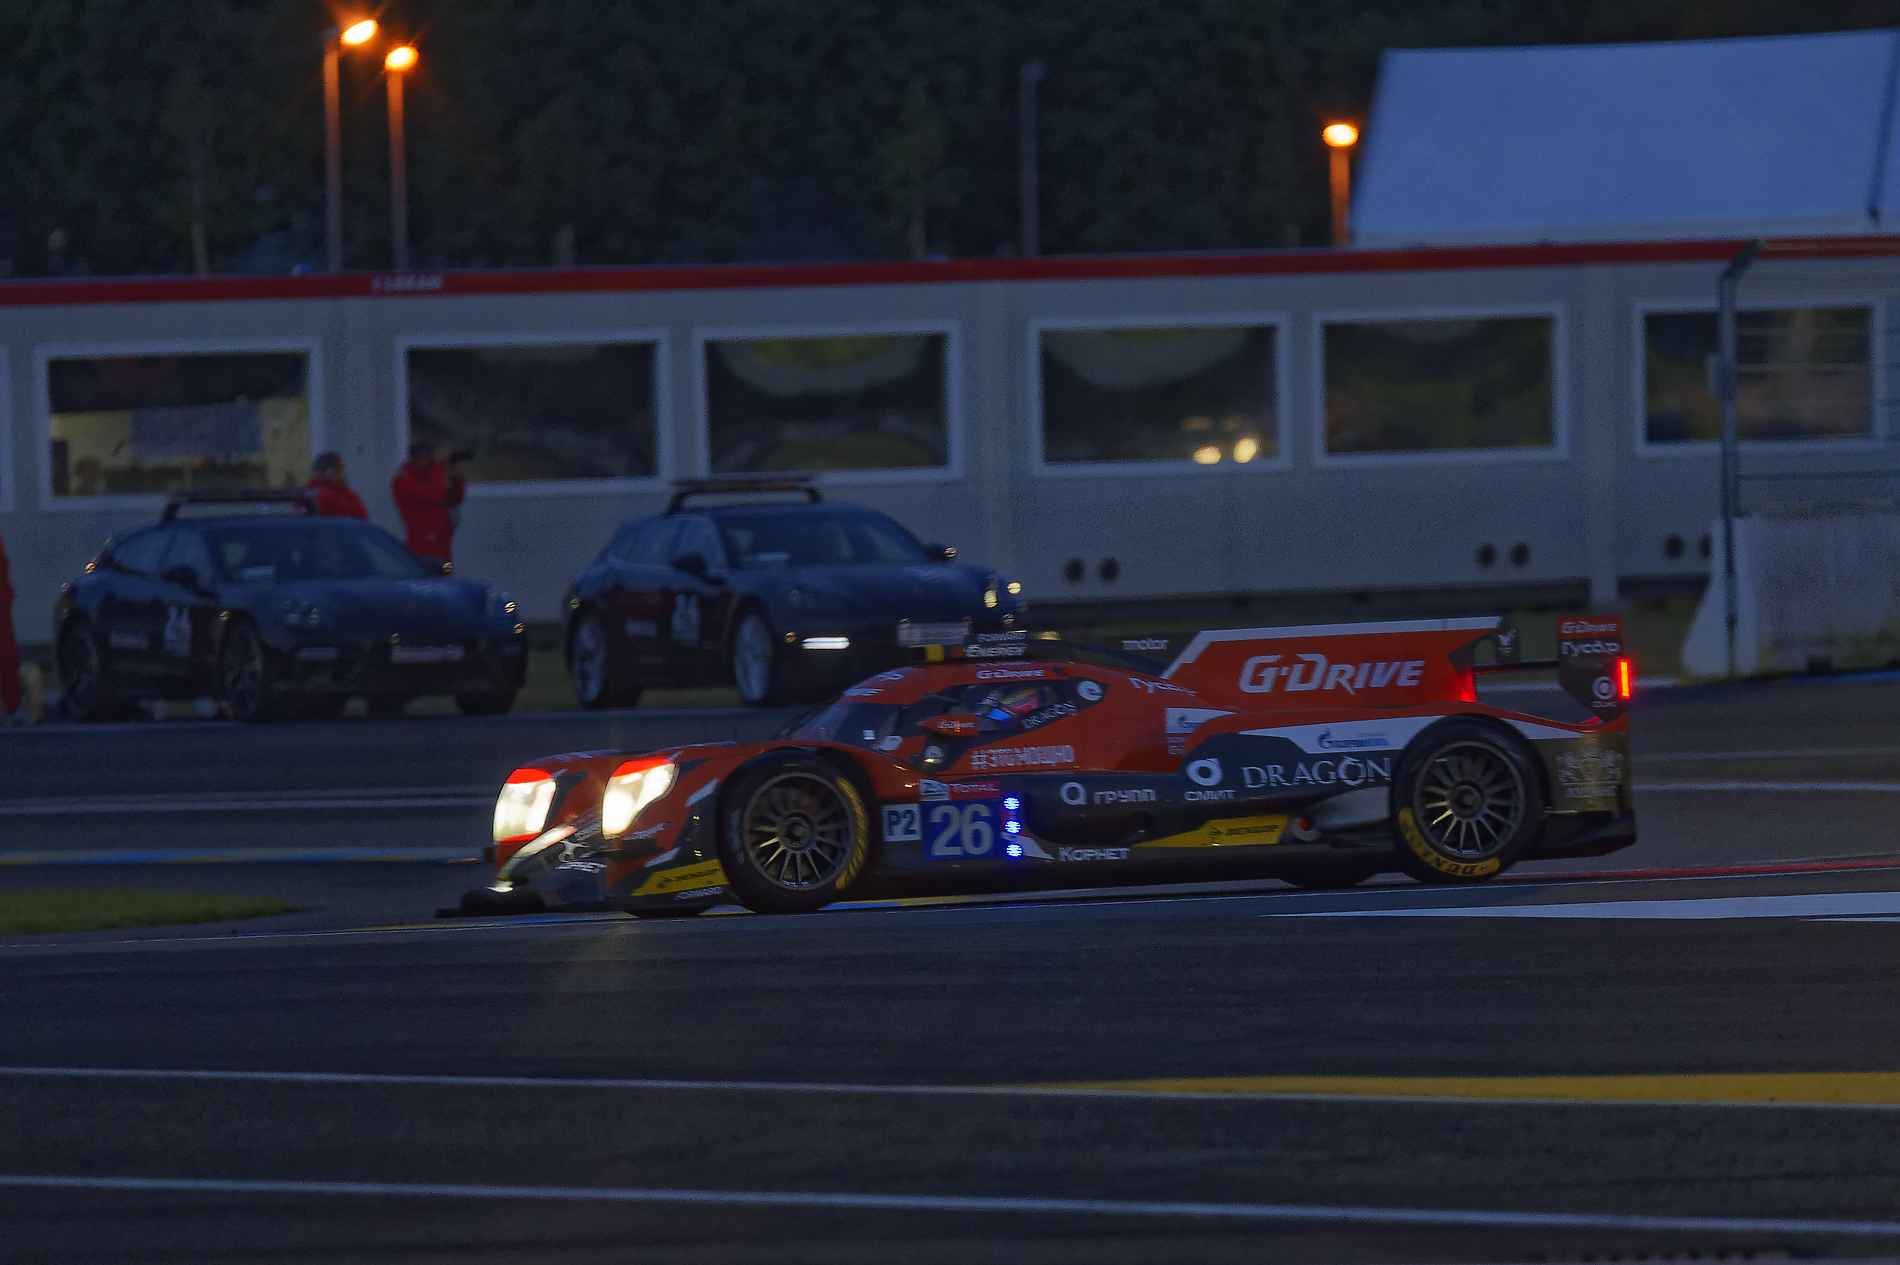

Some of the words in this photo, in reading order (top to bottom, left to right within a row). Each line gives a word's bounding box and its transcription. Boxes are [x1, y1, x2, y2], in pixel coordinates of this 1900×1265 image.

[1242, 756, 1393, 788] DRAGON
[887, 809, 917, 837] P2
[929, 803, 994, 856] 26
